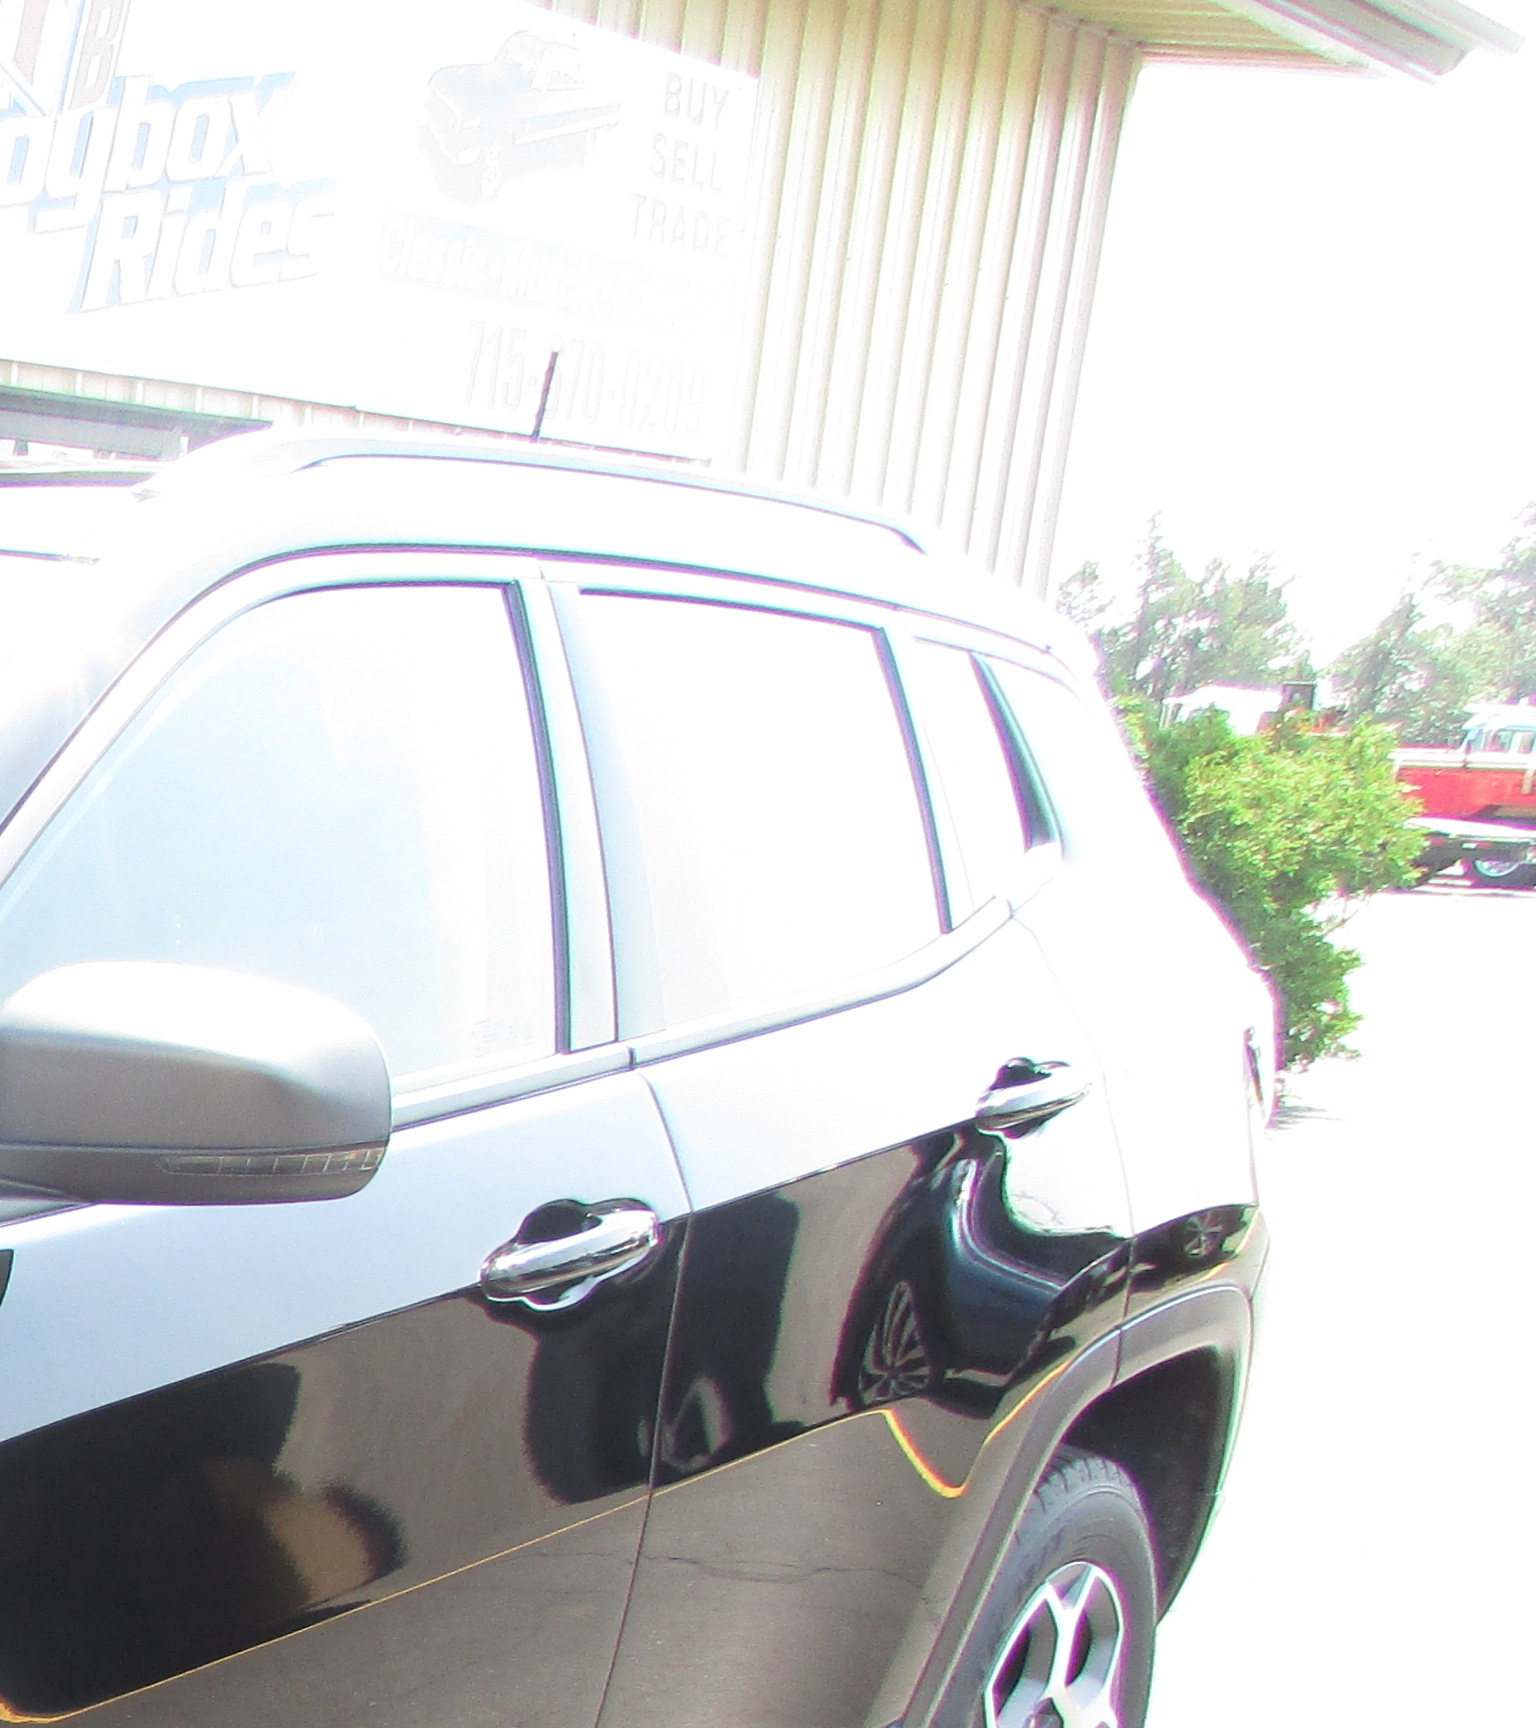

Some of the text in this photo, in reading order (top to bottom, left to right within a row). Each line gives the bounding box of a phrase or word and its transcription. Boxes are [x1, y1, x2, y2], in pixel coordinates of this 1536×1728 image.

[663, 70, 730, 131] BUY
[650, 132, 722, 194] SELL
[66, 176, 337, 315] Rides
[631, 192, 730, 258] TRADE
